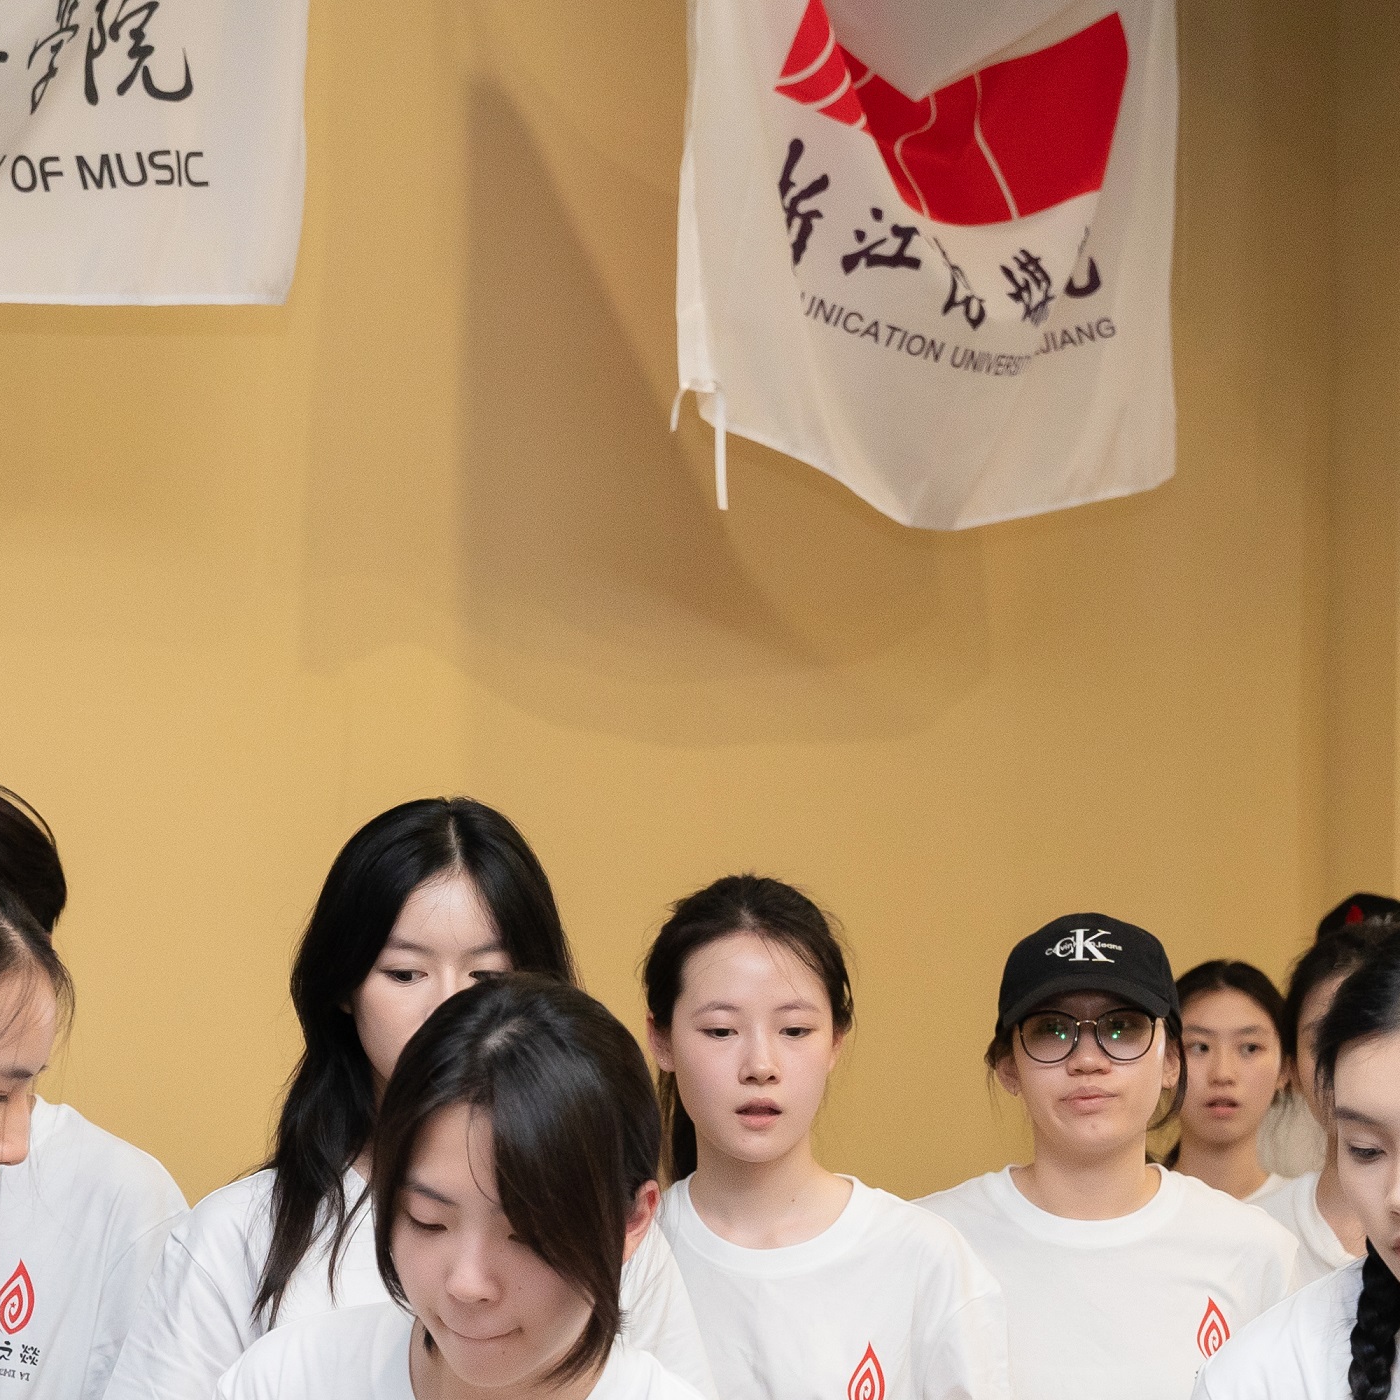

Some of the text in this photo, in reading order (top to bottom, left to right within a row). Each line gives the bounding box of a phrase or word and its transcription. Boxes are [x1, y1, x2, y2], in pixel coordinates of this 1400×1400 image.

[11, 156, 65, 194] OF
[75, 149, 210, 190] MUSIC
[1034, 317, 1117, 355] JIANG
